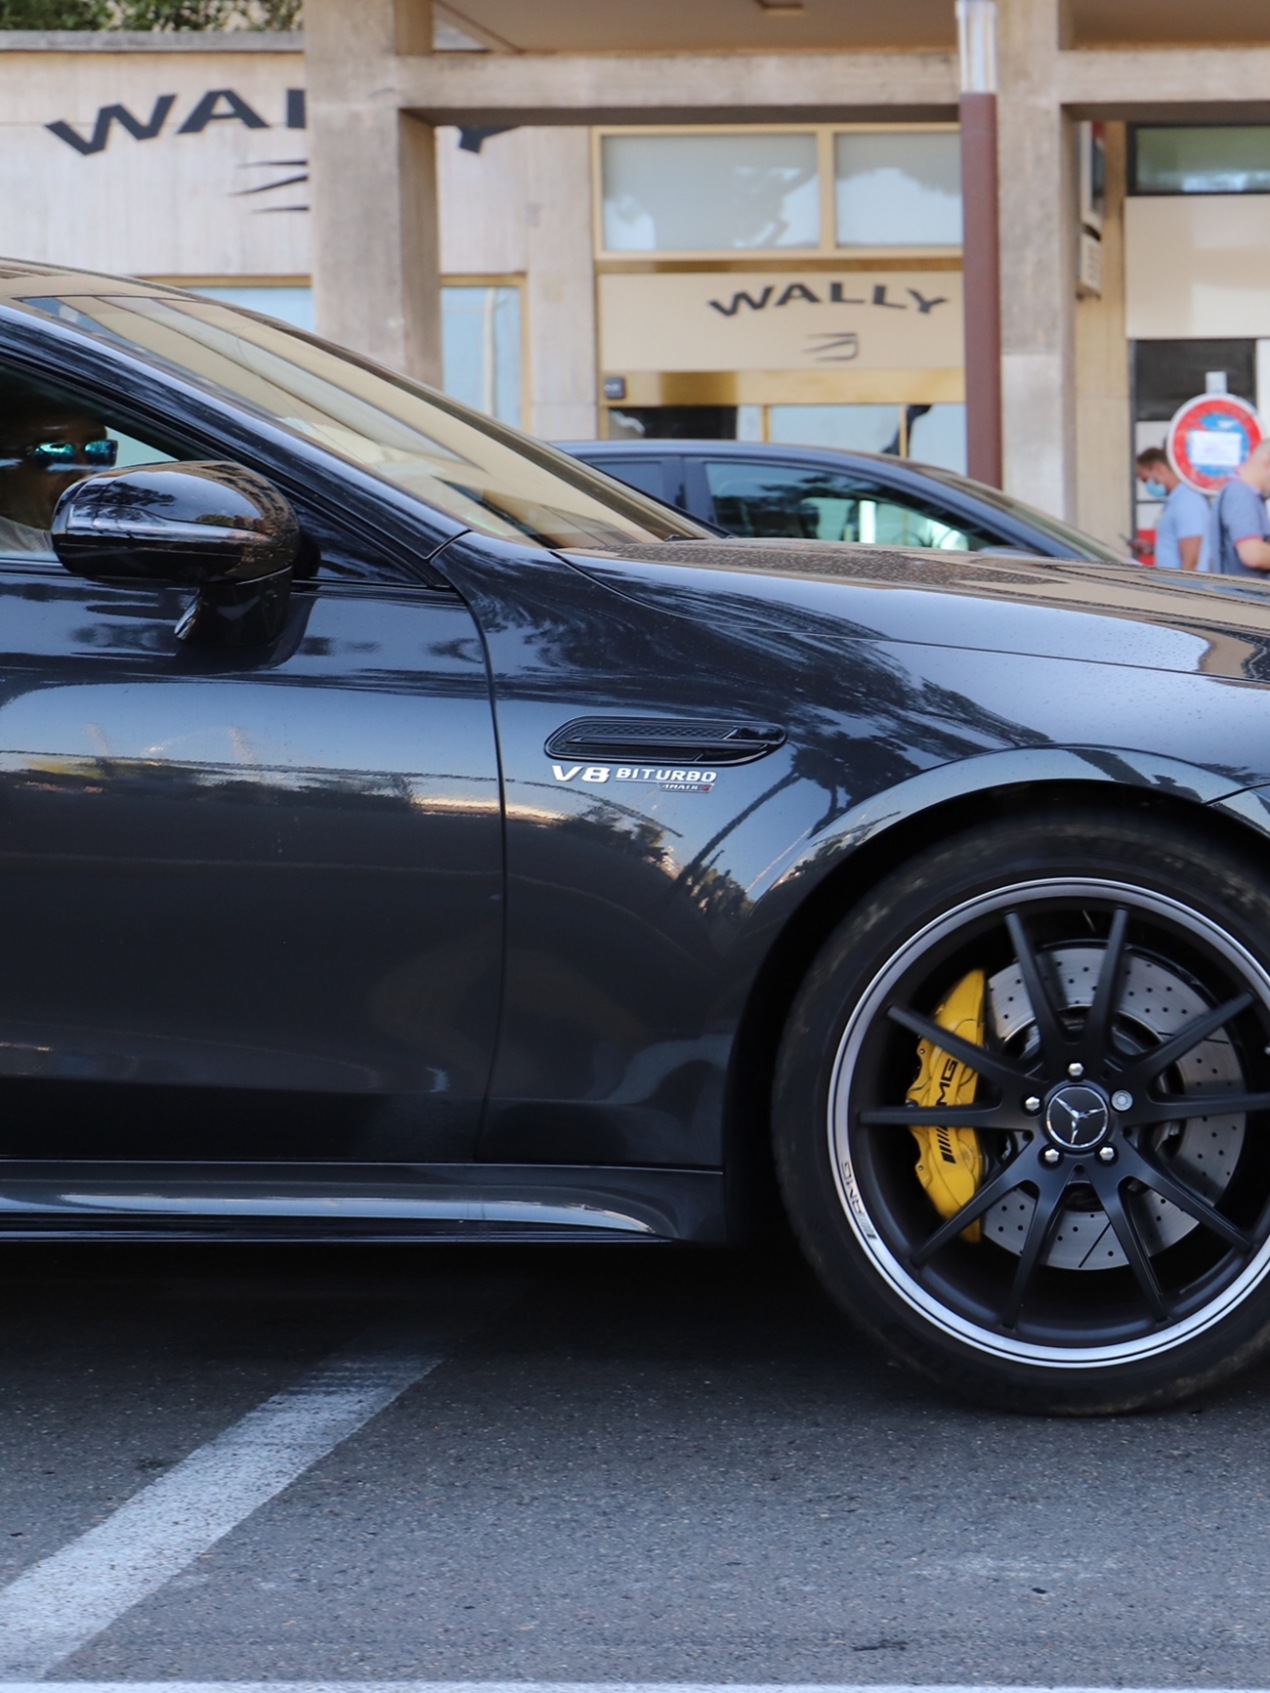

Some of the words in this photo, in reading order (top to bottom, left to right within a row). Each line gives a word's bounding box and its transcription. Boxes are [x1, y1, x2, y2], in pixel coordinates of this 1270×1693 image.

[708, 282, 949, 317] WALLY
[552, 765, 611, 784] V8
[615, 767, 717, 782] BITURBO
